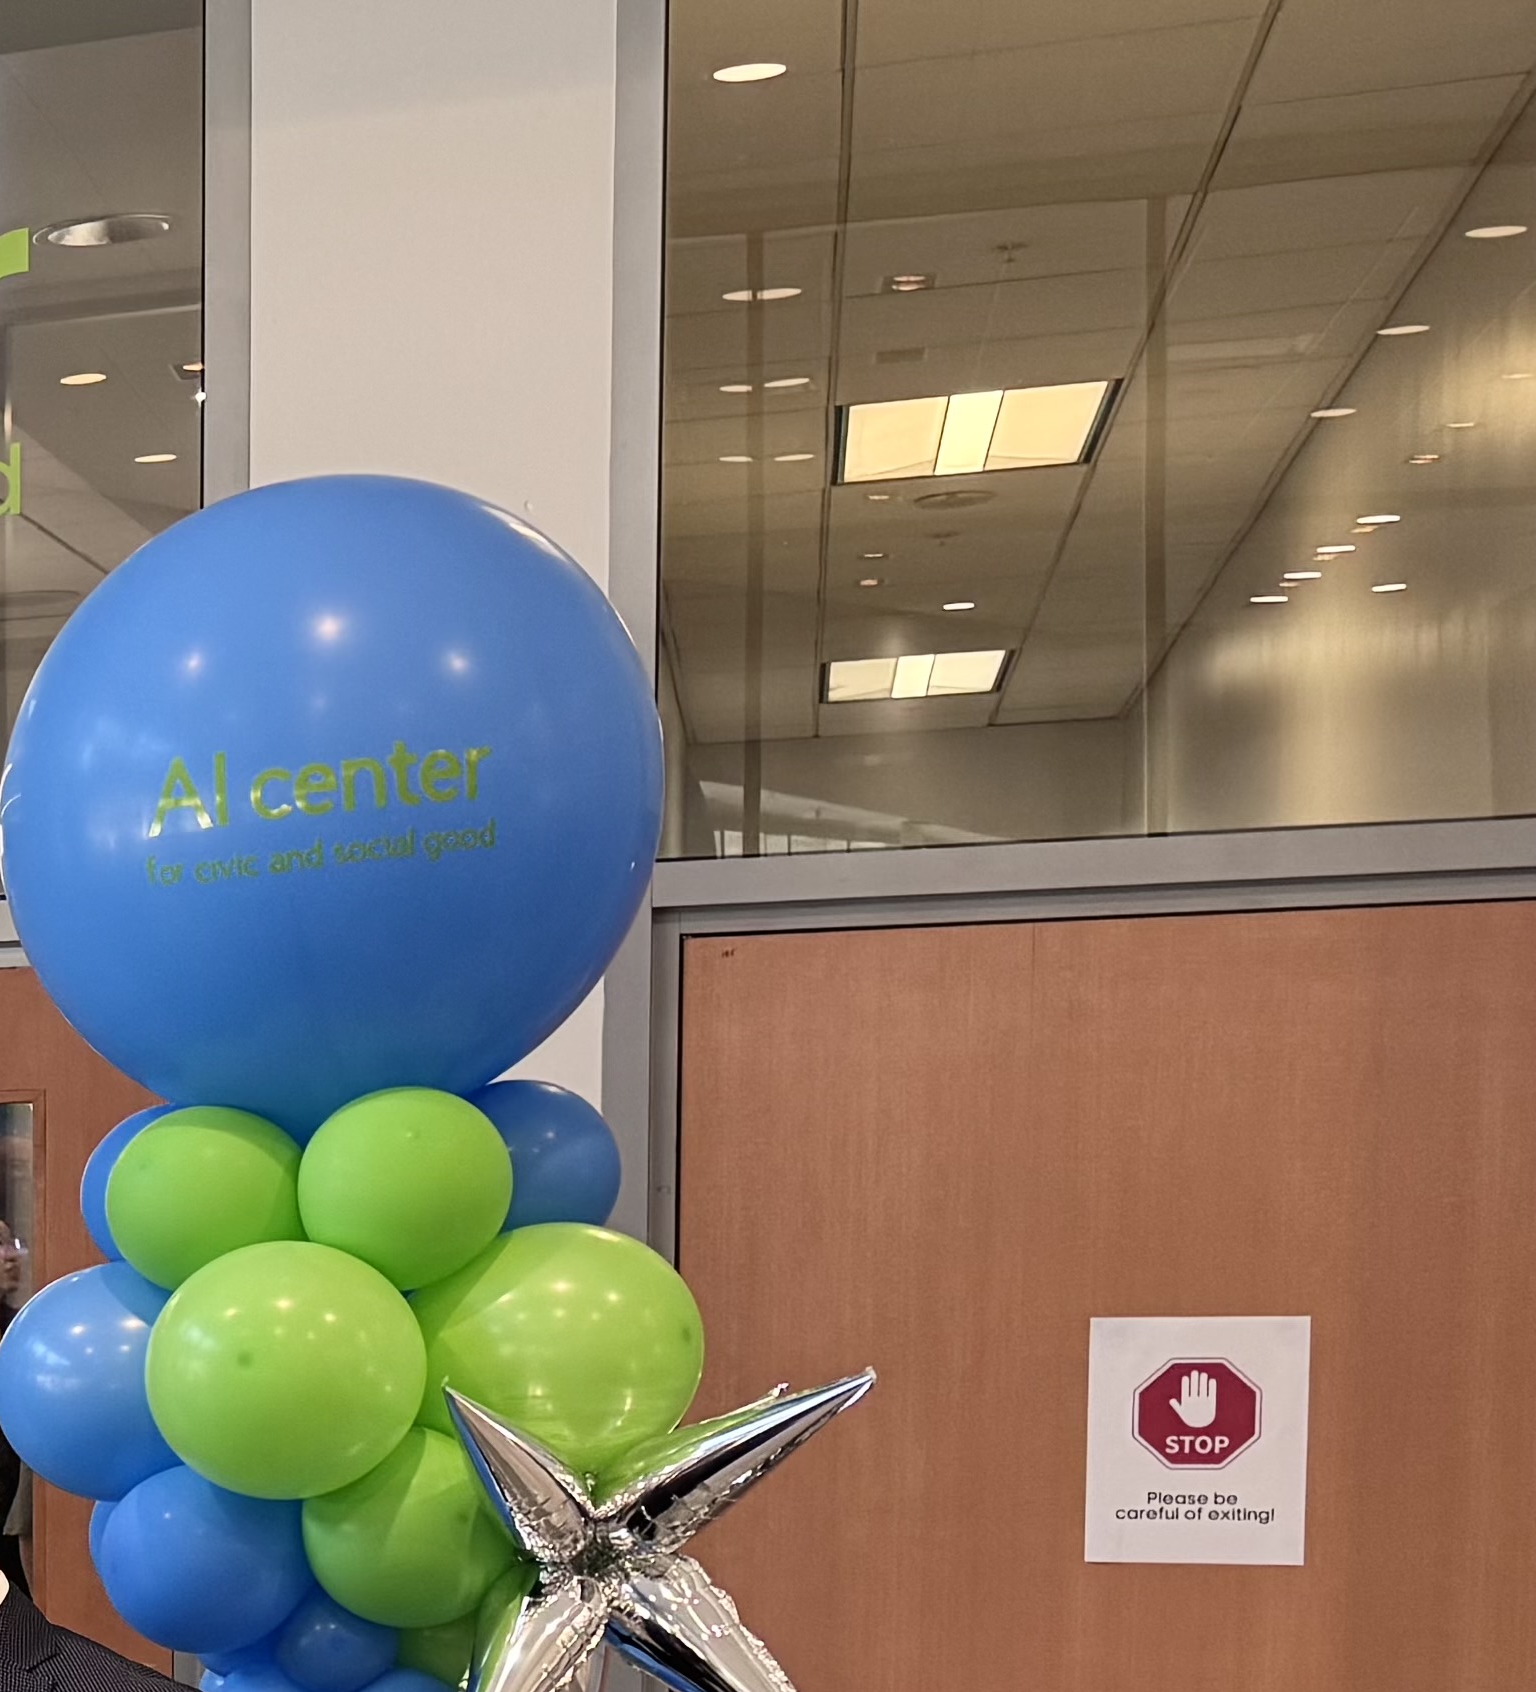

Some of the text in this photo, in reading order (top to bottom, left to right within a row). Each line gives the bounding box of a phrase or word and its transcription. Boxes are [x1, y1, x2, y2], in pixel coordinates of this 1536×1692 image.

[148, 740, 492, 838] AI center
[146, 817, 497, 887] for civic and social good
[1165, 1435, 1230, 1454] STOP
[1147, 1491, 1238, 1505] Please be
[1115, 1506, 1275, 1525] careful of exiting!
